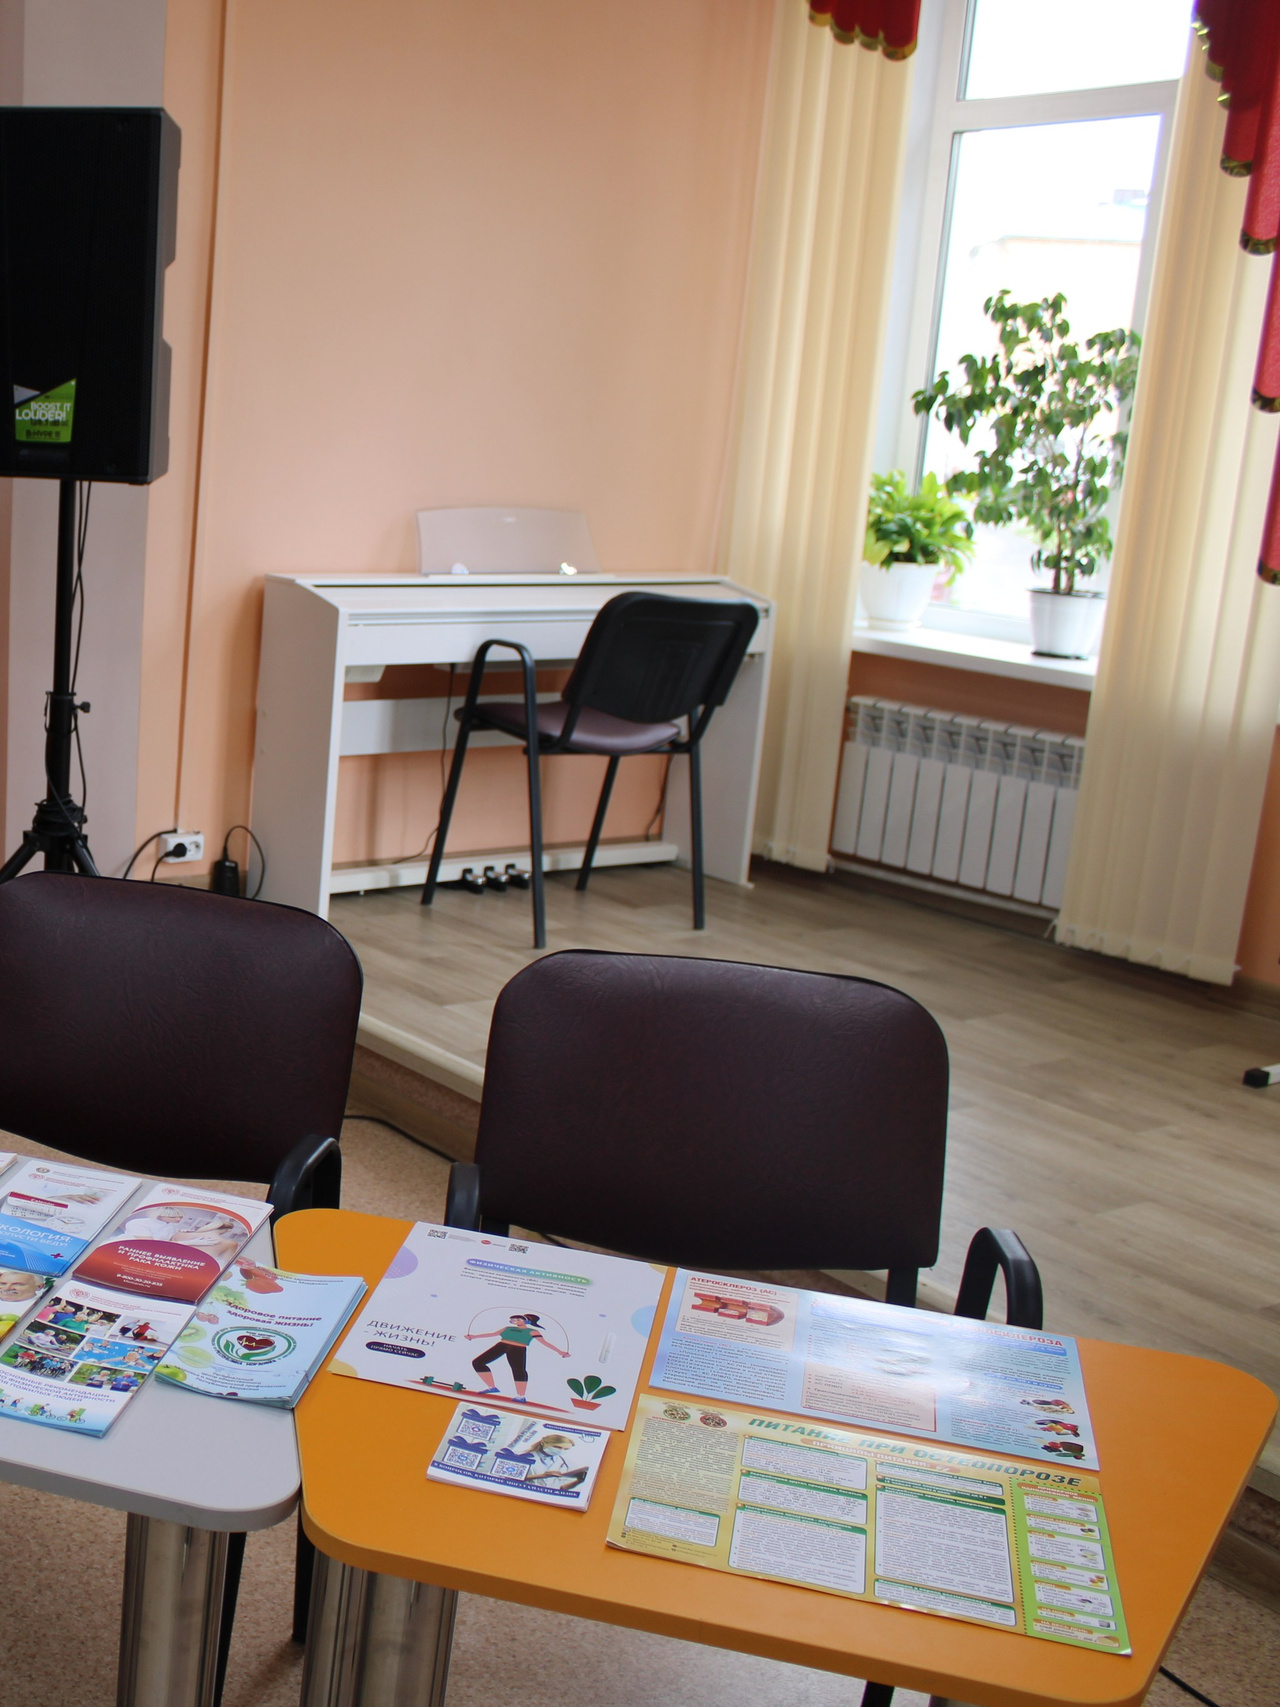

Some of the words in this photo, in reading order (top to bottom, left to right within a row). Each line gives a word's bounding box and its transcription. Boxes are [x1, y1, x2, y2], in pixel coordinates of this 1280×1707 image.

[118, 1245, 153, 1257] РАННЕЕ
[128, 1256, 152, 1266] РАКА
[154, 1261, 183, 1271] КОЖИ
[468, 1259, 527, 1275] ФИЗИЧЕСКАЯ
[529, 1270, 588, 1285] АКТИВНОСТЬ
[690, 1276, 757, 1293] АТЕРОСКЛЕРОЗ
[225, 1300, 276, 1319] Здоровое
[277, 1314, 322, 1322] питание
[226, 1309, 272, 1325] здоровая
[366, 1319, 457, 1343] ДВИЖЕНИЕ
[373, 1329, 436, 1347] ЖИЗНЬ!
[748, 1417, 852, 1444] ПИТАНИЕ
[858, 1438, 906, 1455] ПРИ
[912, 1449, 1083, 1488] ОСТЕОПОРОЗЕ
[811, 1439, 875, 1458] ПРИНЦИПЫ
